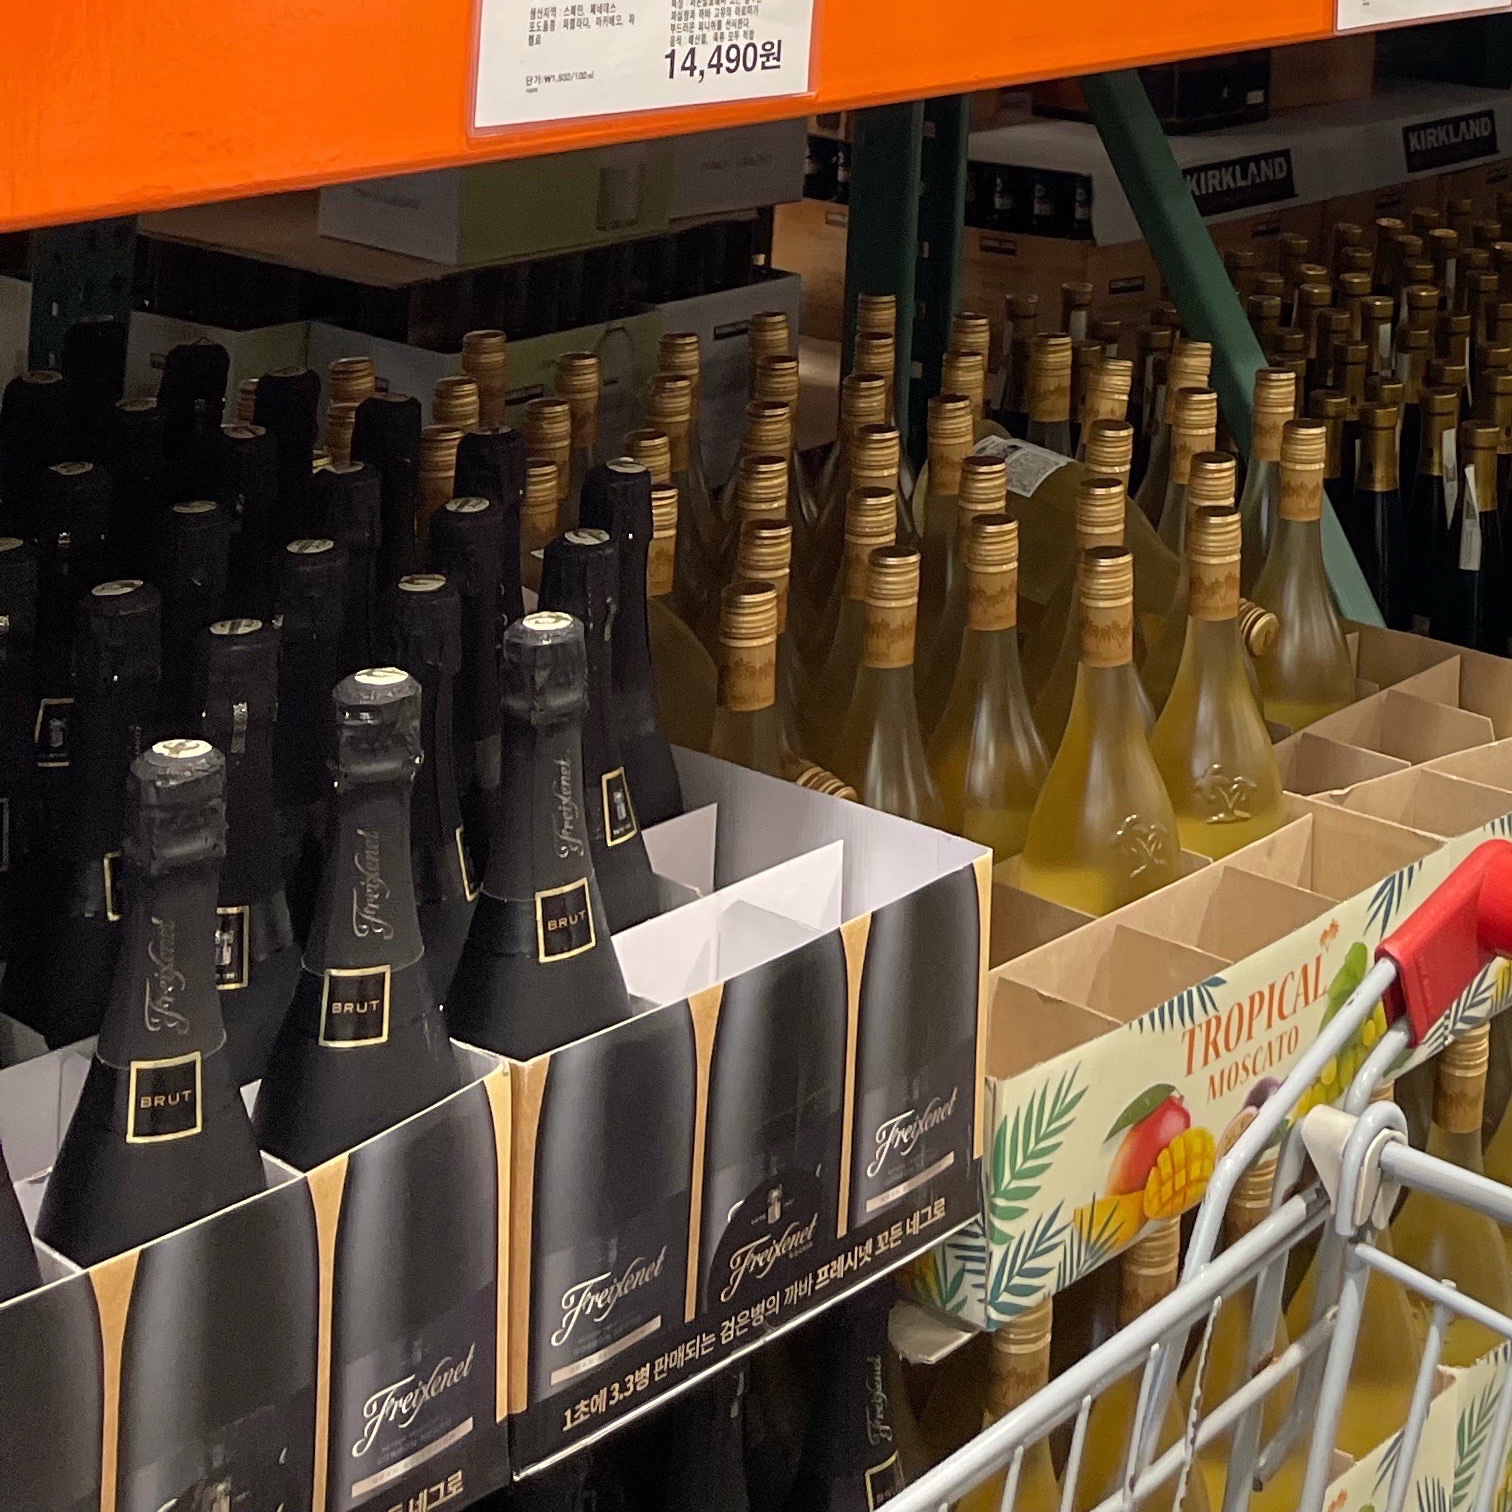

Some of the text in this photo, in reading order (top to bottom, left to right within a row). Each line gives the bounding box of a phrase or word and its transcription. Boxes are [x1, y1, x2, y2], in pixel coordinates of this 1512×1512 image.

[664, 39, 782, 83] 14,490원
[1408, 116, 1492, 152] KIRKLAND
[1185, 156, 1288, 195] KIRKLAND
[547, 908, 587, 932] BRUT
[332, 998, 380, 1014] BRUT
[1180, 955, 1330, 1077] TROPICAL
[140, 1089, 191, 1109] BRUT
[1206, 1026, 1300, 1105] MOSCATO
[866, 1087, 958, 1177] Freixenet
[551, 1245, 667, 1347] Freixenet
[720, 1213, 819, 1302] Freixenet
[562, 1386, 607, 1433] 1초에
[609, 1365, 651, 1407] 3.3병
[653, 1332, 717, 1382] 판매되는
[720, 1295, 780, 1345] 검은병의
[815, 1246, 873, 1290] 프레시넷
[905, 1197, 947, 1236] 네그로
[352, 1343, 476, 1458] Freixenet
